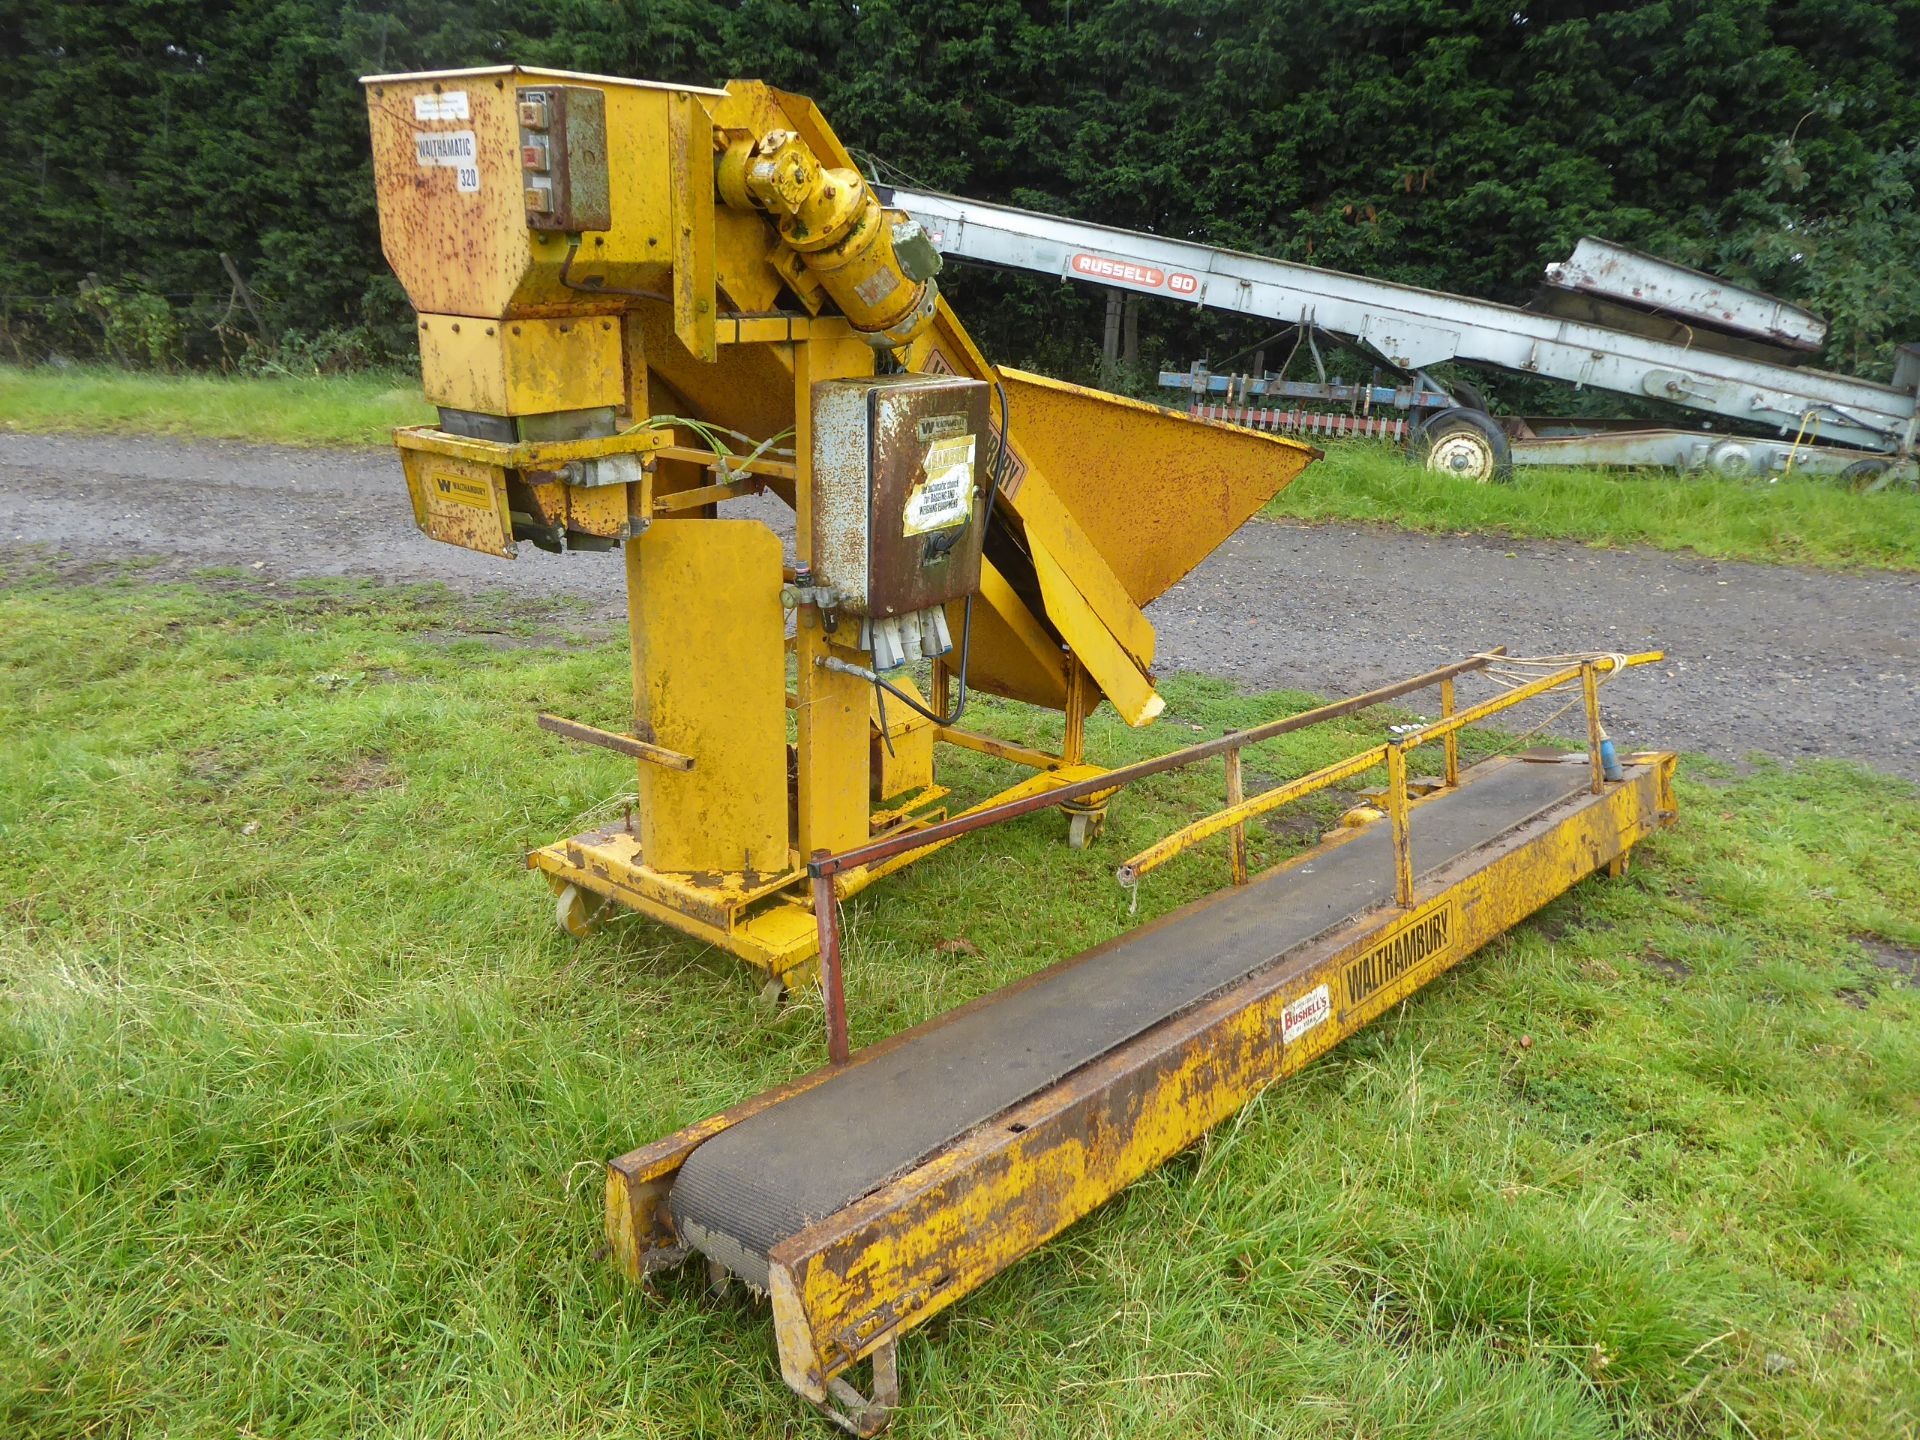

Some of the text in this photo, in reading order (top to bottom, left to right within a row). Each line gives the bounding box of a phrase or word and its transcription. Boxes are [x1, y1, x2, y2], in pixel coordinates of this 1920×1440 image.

[418, 137, 472, 158] WALTHAMATIC
[460, 168, 476, 187] 320
[1079, 256, 1194, 291] RUSSELL 90
[921, 421, 935, 434] W
[436, 478, 451, 494] W
[1345, 908, 1448, 1005] WALTHAMBURY
